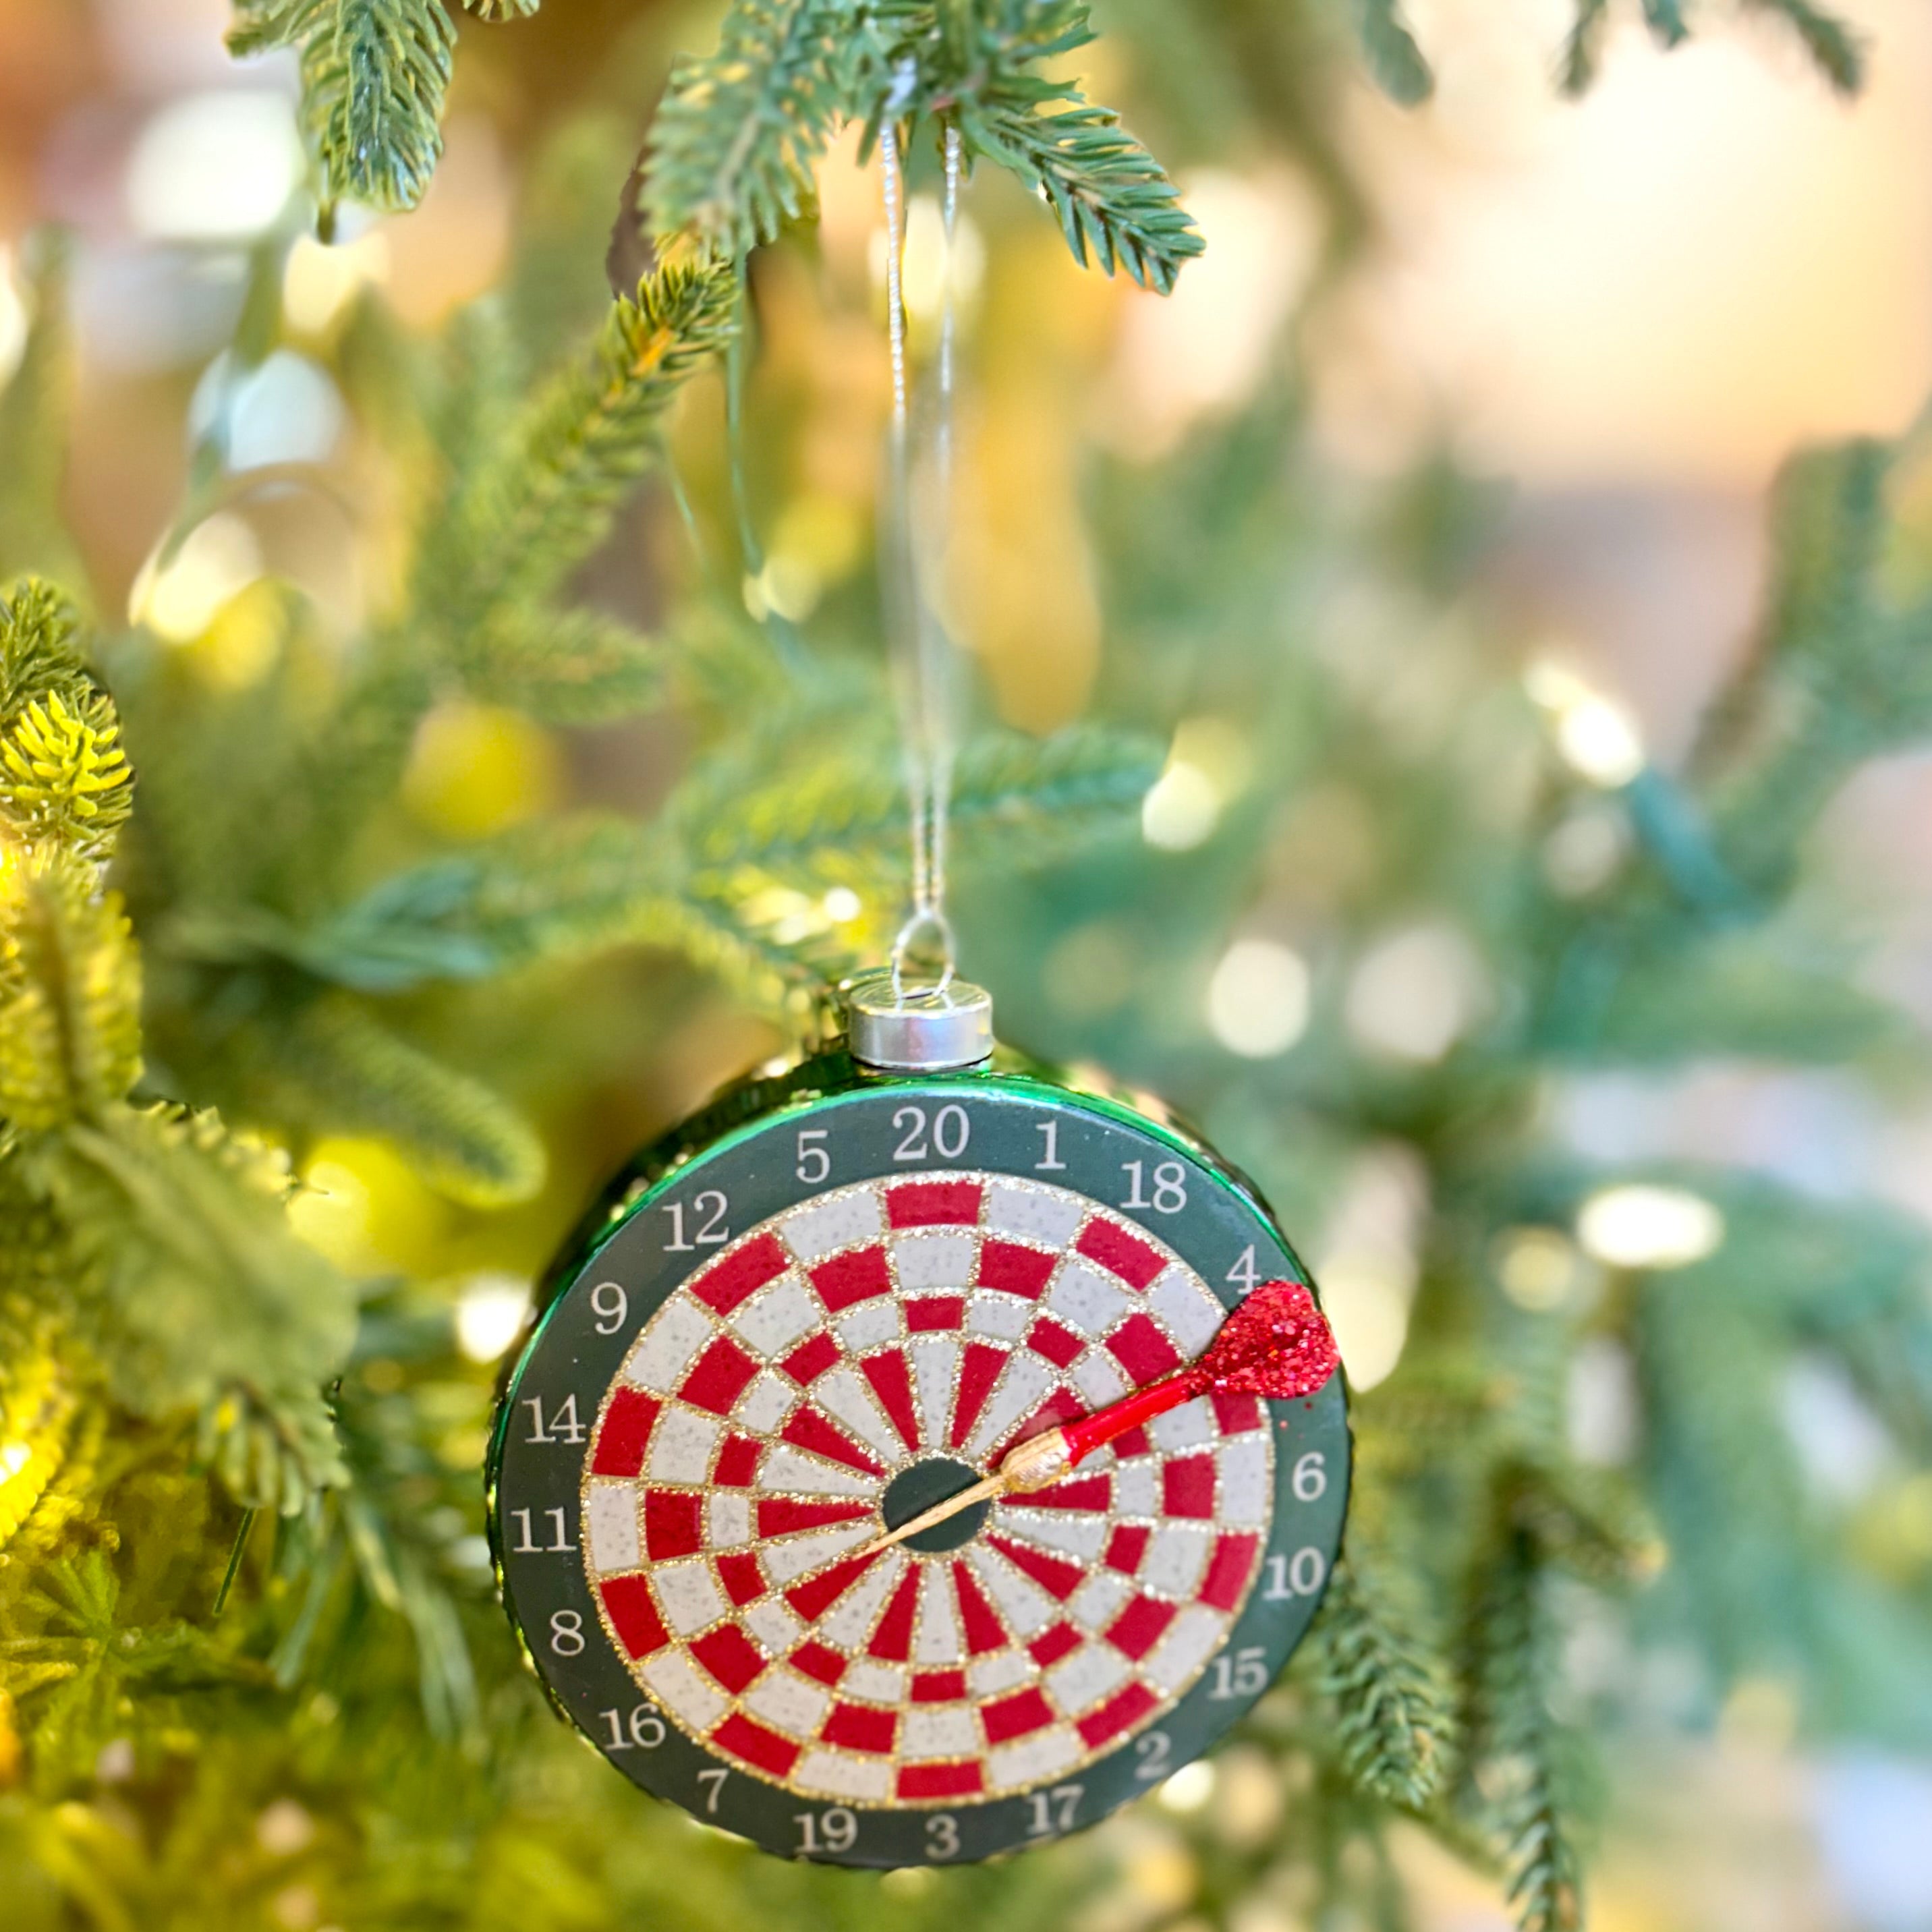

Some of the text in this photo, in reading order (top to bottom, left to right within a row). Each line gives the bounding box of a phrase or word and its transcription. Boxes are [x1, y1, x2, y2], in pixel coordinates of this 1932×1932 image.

[797, 1130, 829, 1183] 5
[893, 1105, 969, 1160] 20
[1035, 1120, 1065, 1169] 1
[1119, 1162, 1186, 1213] 18
[662, 1191, 731, 1252] 12
[1226, 1245, 1261, 1294] 4
[592, 1282, 627, 1334] 9
[523, 1394, 586, 1443] 14
[1292, 1452, 1326, 1501] 6
[511, 1507, 577, 1552] 11
[1263, 1550, 1324, 1599] 10
[550, 1610, 585, 1655] 8
[1211, 1647, 1268, 1697] 15
[599, 1703, 666, 1749] 16
[1136, 1730, 1170, 1779] 2
[698, 1769, 729, 1811] 7
[1025, 1786, 1083, 1834] 17
[795, 1808, 857, 1852] 19
[926, 1815, 959, 1857] 3
